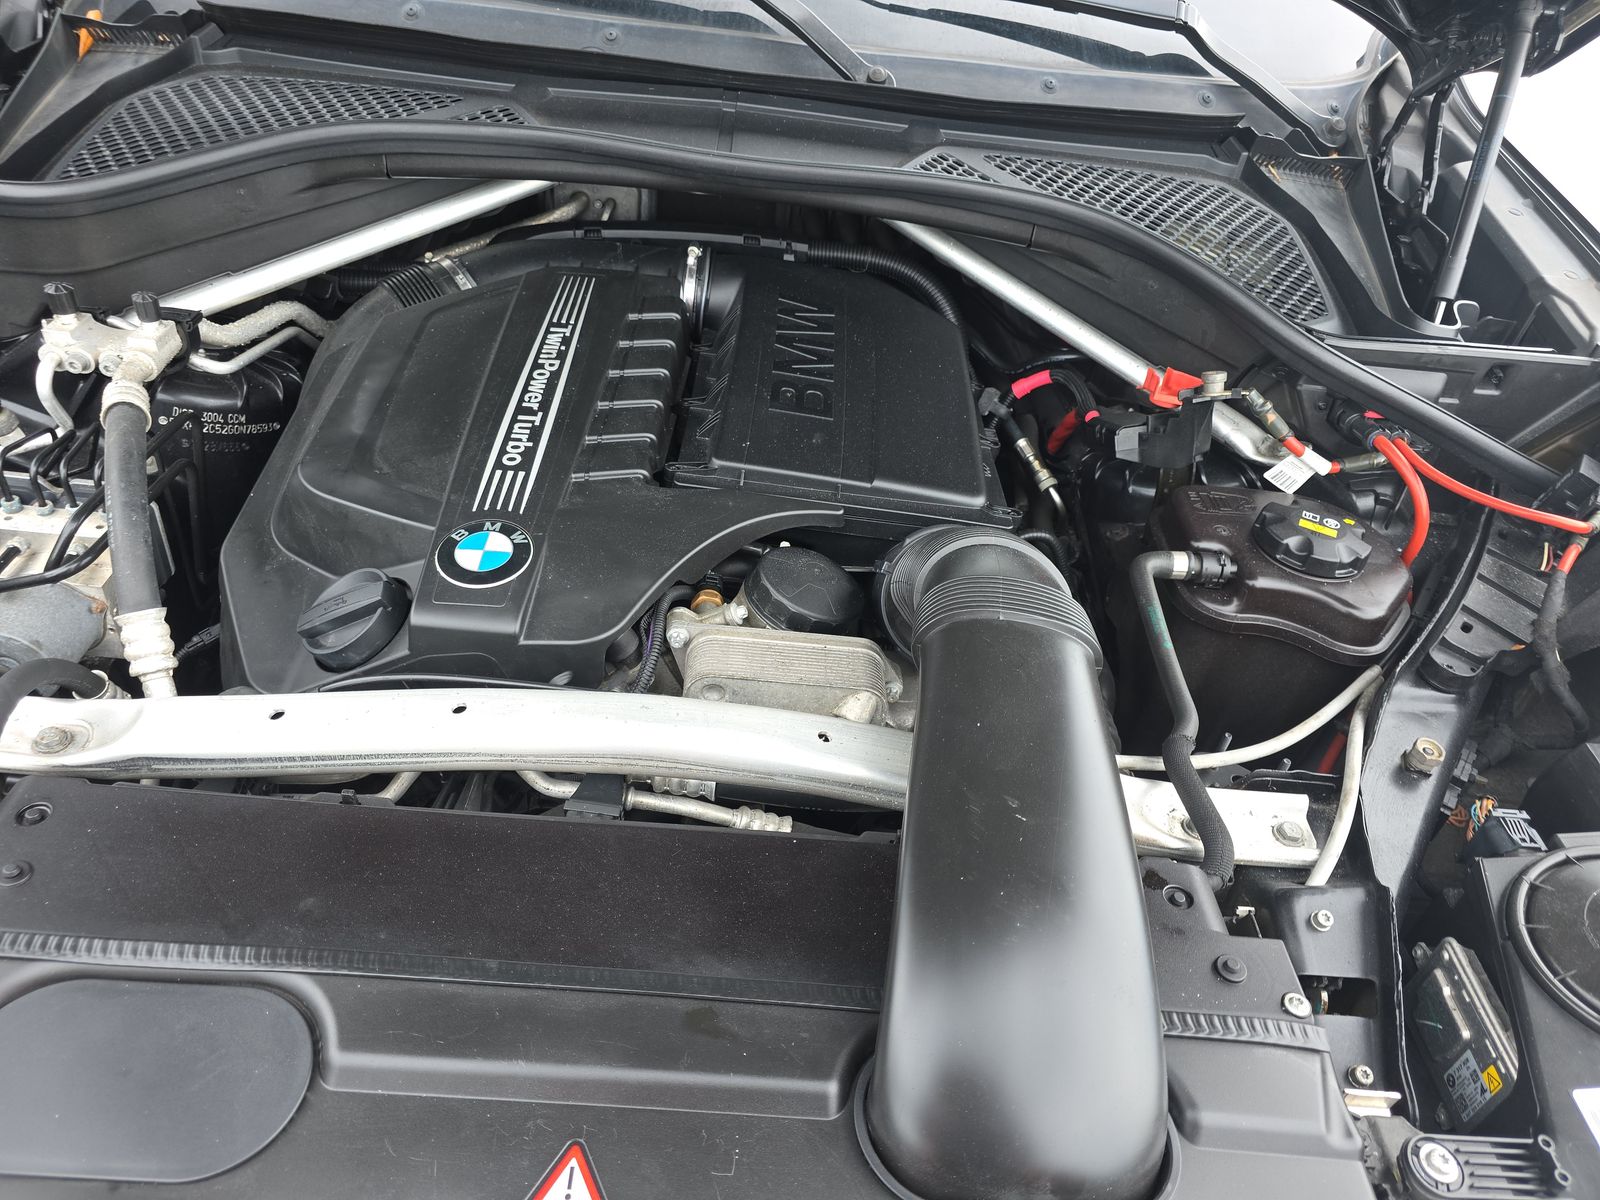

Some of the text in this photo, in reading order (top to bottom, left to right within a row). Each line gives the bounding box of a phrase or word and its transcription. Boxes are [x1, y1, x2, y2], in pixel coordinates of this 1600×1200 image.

[768, 297, 835, 420] BMW
[201, 411, 224, 424] 3004
[228, 413, 246, 424] CCM
[502, 325, 573, 466] TwinPower Turbo
[451, 521, 529, 544] BMW
